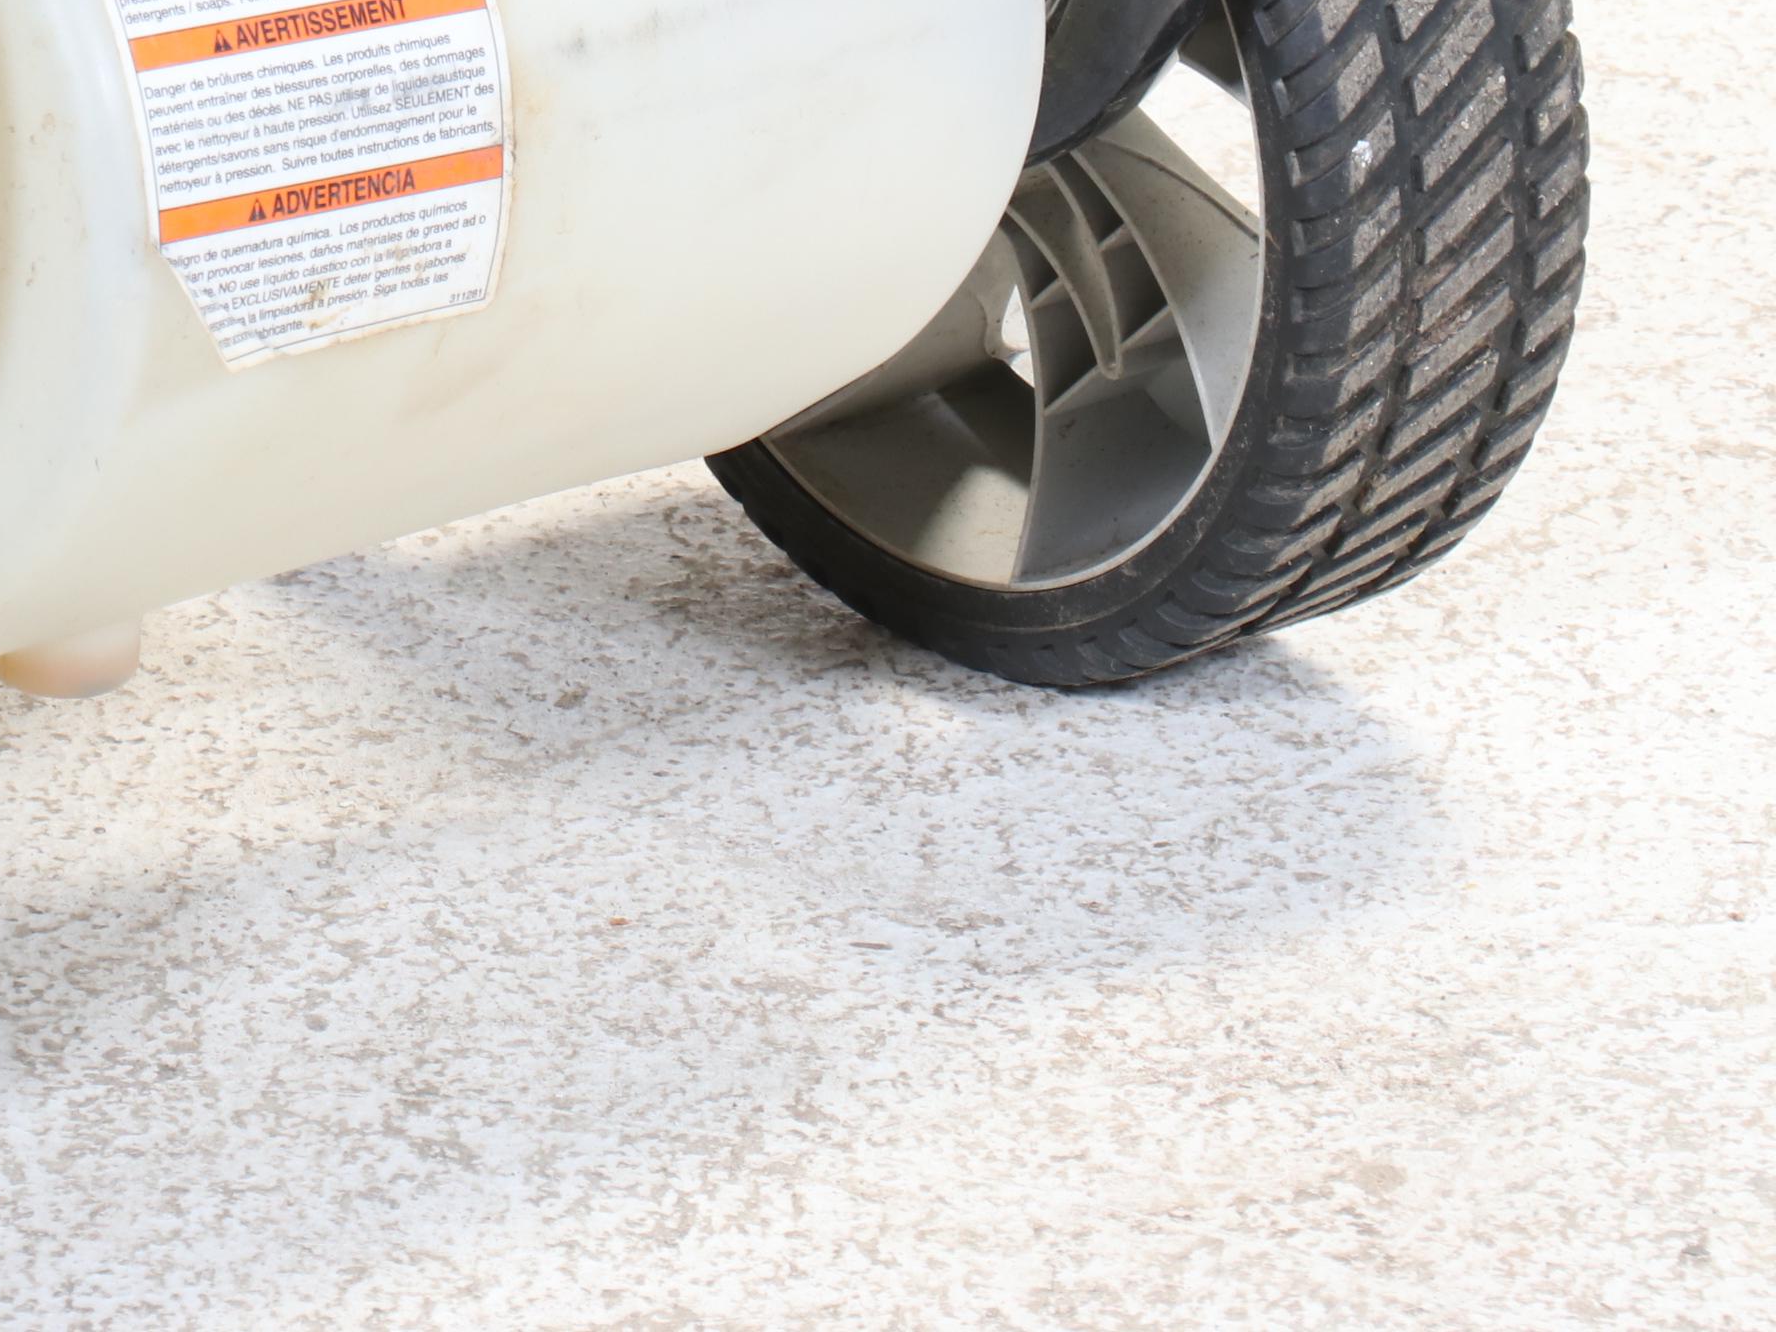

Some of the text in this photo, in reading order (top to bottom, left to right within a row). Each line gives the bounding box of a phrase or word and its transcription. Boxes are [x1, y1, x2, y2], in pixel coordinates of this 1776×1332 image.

[124, 4, 186, 25] detergents
[144, 34, 451, 99] Danger de brûlures chimiques. Les produits chimiques
[149, 101, 194, 120] peuvent
[251, 86, 271, 99] des
[274, 75, 328, 93] blessures
[331, 66, 396, 84] corporelles,
[399, 59, 420, 71] des
[424, 46, 485, 67] dommages
[152, 119, 204, 137] matériels
[207, 116, 222, 126] ou
[225, 111, 246, 124] des
[288, 99, 304, 111] NE
[309, 91, 333, 107] PAS
[335, 87, 371, 104] utiliser
[375, 83, 389, 95] de
[392, 76, 429, 93] liquide
[432, 66, 485, 84] caustique
[155, 143, 182, 156] avec
[184, 139, 195, 150] le
[198, 128, 249, 149] nettoyeur
[253, 128, 260, 138] à
[263, 119, 295, 134] haute
[351, 102, 391, 119] Utilisez
[395, 85, 470, 111] SEULEMENT
[474, 83, 495, 96] des
[157, 106, 477, 176] détergents/savons sans risque d'endommagement pour le
[159, 175, 211, 194] nettoyeur
[215, 171, 222, 184] à
[225, 163, 274, 184] pression.
[281, 152, 318, 171] Suivre
[320, 147, 354, 163] toutes
[357, 134, 420, 155] instructions
[423, 130, 437, 142] de
[271, 167, 416, 219] ADVERTENCIA
[204, 250, 218, 262] de
[221, 238, 283, 258] quemadura
[287, 227, 332, 246] química.
[339, 221, 359, 236] Los
[362, 210, 416, 231] productos
[419, 200, 467, 219] químicos
[207, 261, 256, 280] provocar
[309, 242, 344, 259] daños
[346, 230, 403, 250] materiales
[406, 227, 419, 239] de
[423, 220, 459, 236] graved
[462, 215, 476, 228] ad
[479, 214, 487, 223] o
[219, 281, 236, 294] NO
[240, 278, 260, 290] use
[350, 255, 370, 268] con
[374, 252, 383, 262] la
[444, 239, 452, 248] a
[232, 276, 340, 310] EXCLUSIVAMENTE
[344, 271, 372, 286] deter
[375, 263, 411, 282] gentes
[422, 252, 466, 272] jabones
[248, 313, 256, 324] la
[259, 299, 314, 320] limpiadora
[317, 298, 324, 307] a
[374, 282, 396, 296] Siga
[401, 277, 430, 289] todas
[434, 272, 448, 284] las
